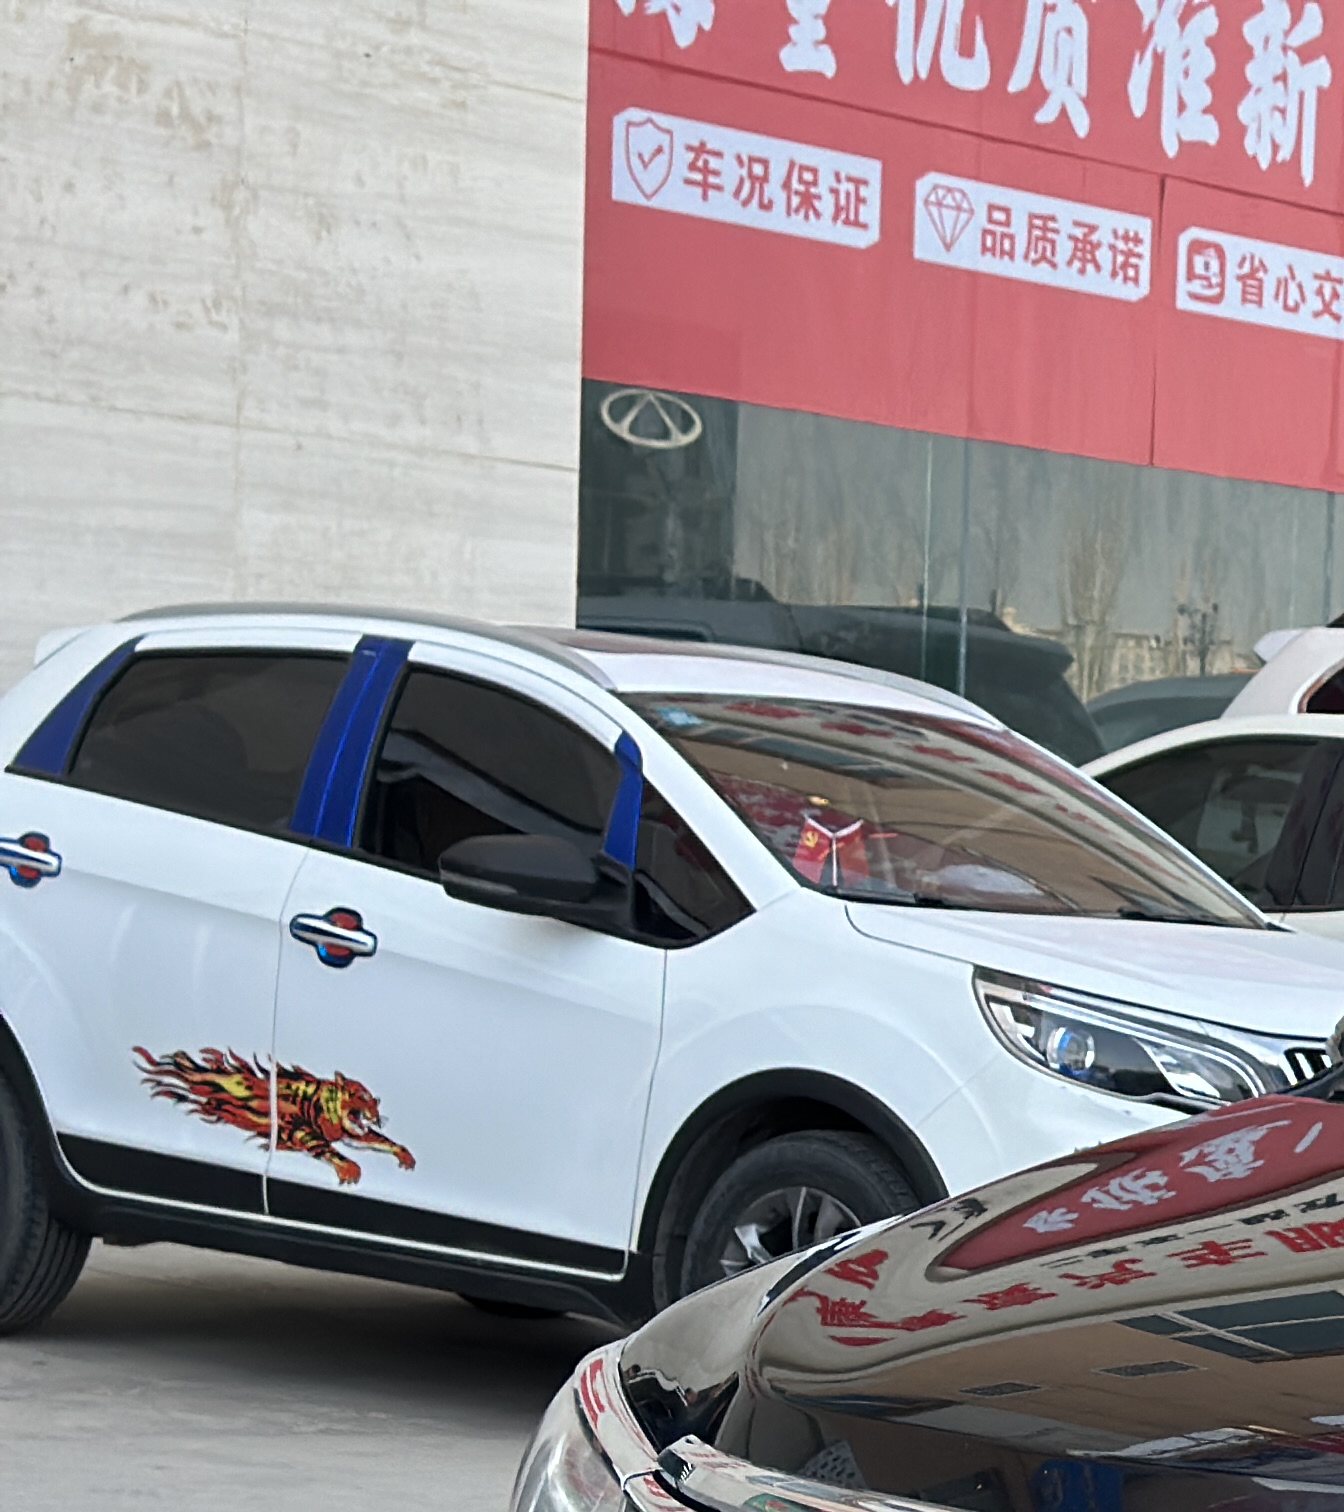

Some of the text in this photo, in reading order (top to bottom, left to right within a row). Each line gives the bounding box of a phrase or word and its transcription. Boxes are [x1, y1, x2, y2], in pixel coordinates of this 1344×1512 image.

[682, 141, 871, 231] 车况保证
[979, 203, 1146, 288] 品质承诺
